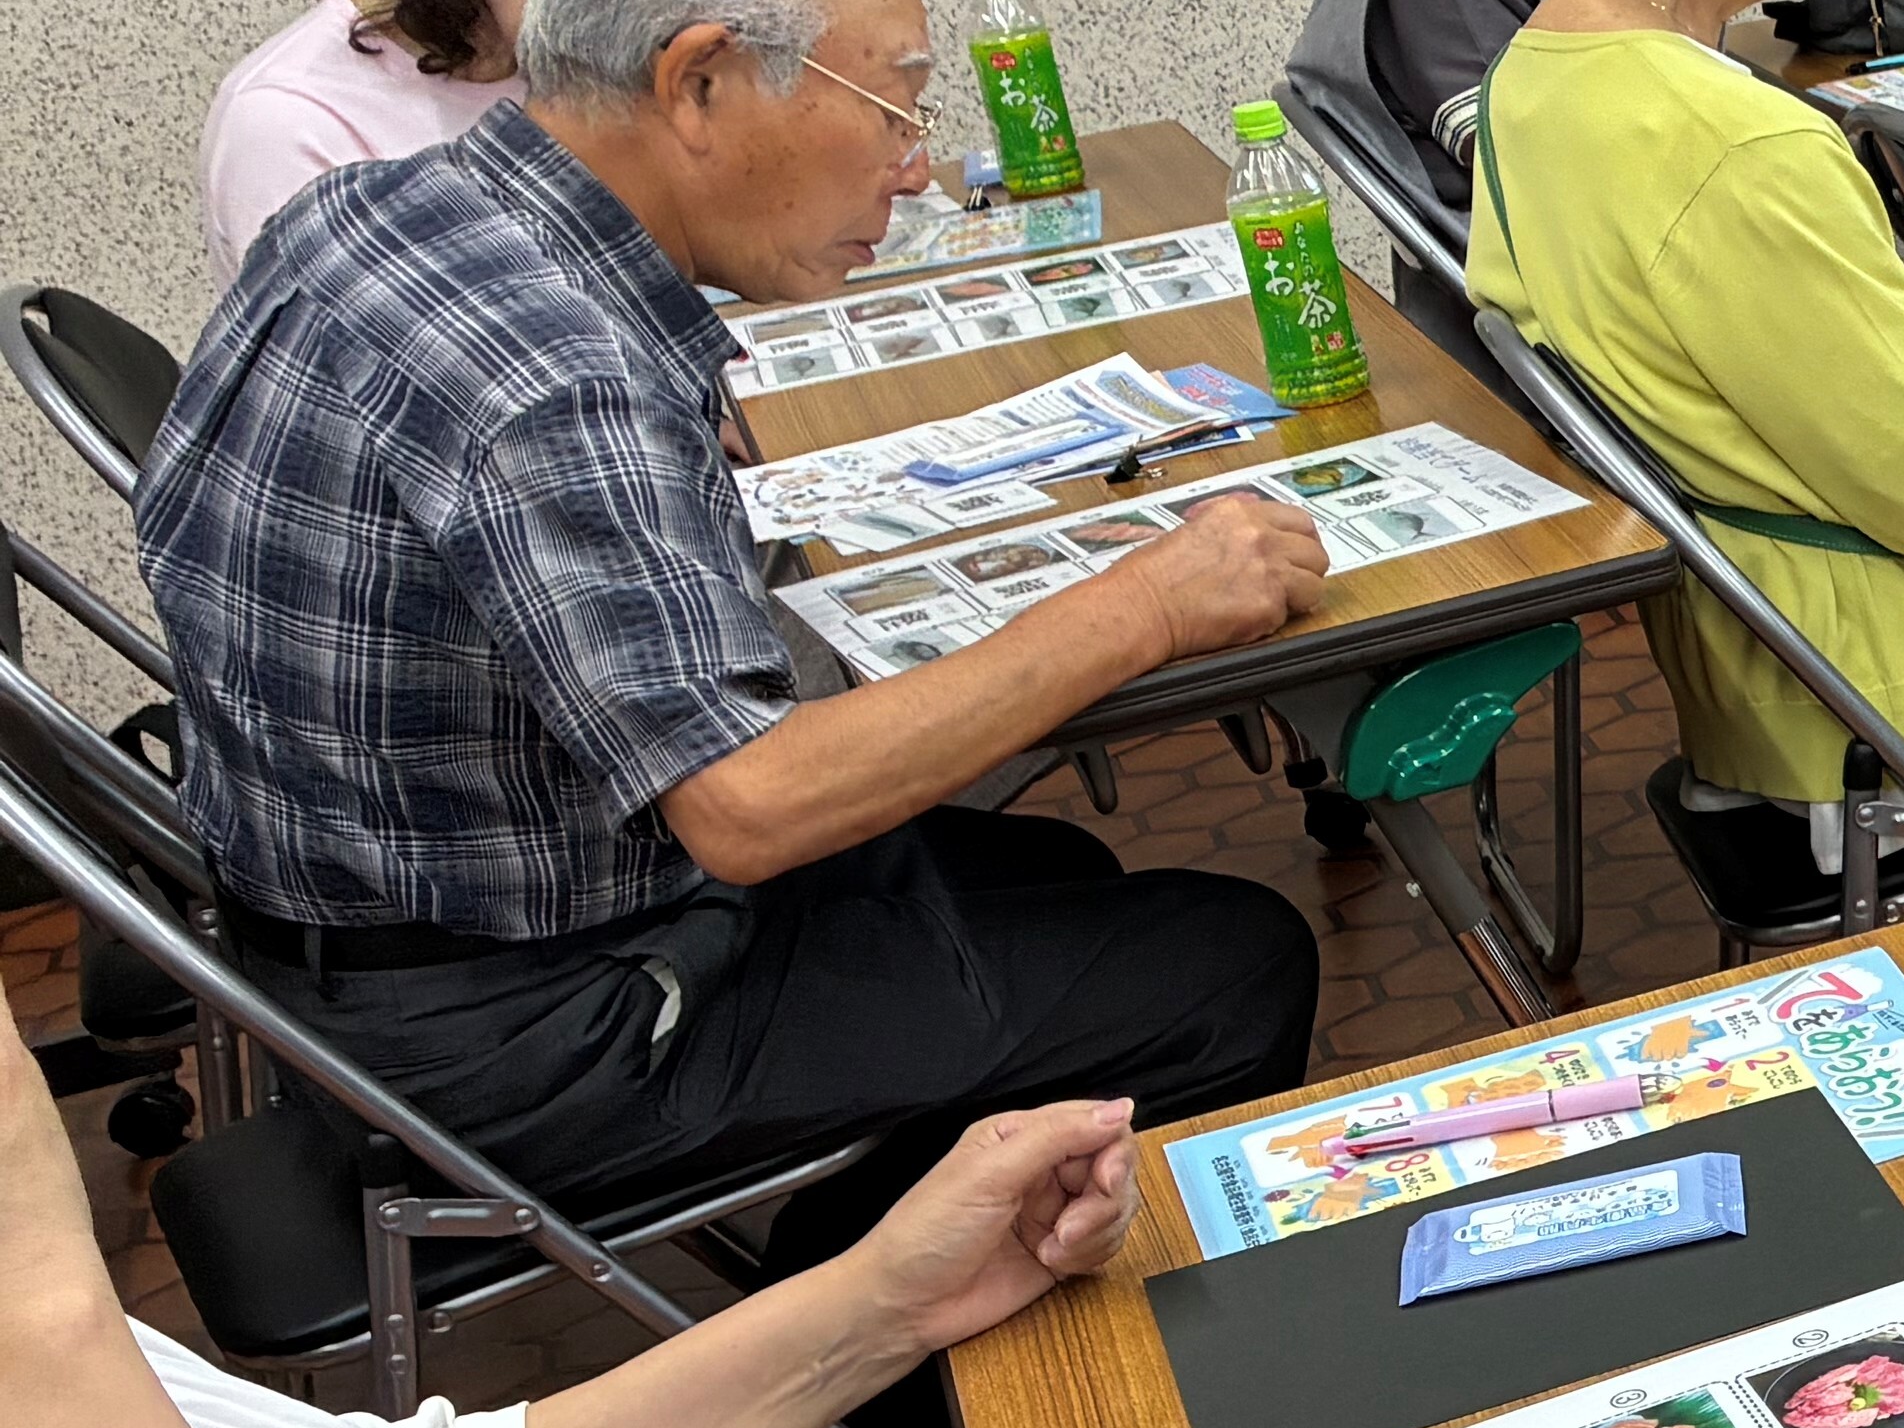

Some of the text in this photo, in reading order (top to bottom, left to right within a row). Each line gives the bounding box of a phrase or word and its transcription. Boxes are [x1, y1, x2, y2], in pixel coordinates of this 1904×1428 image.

[999, 70, 1059, 133] お茶
[1264, 251, 1337, 329] お茶
[1745, 1051, 1789, 1071] 2
[1385, 1153, 1430, 1172] 8
